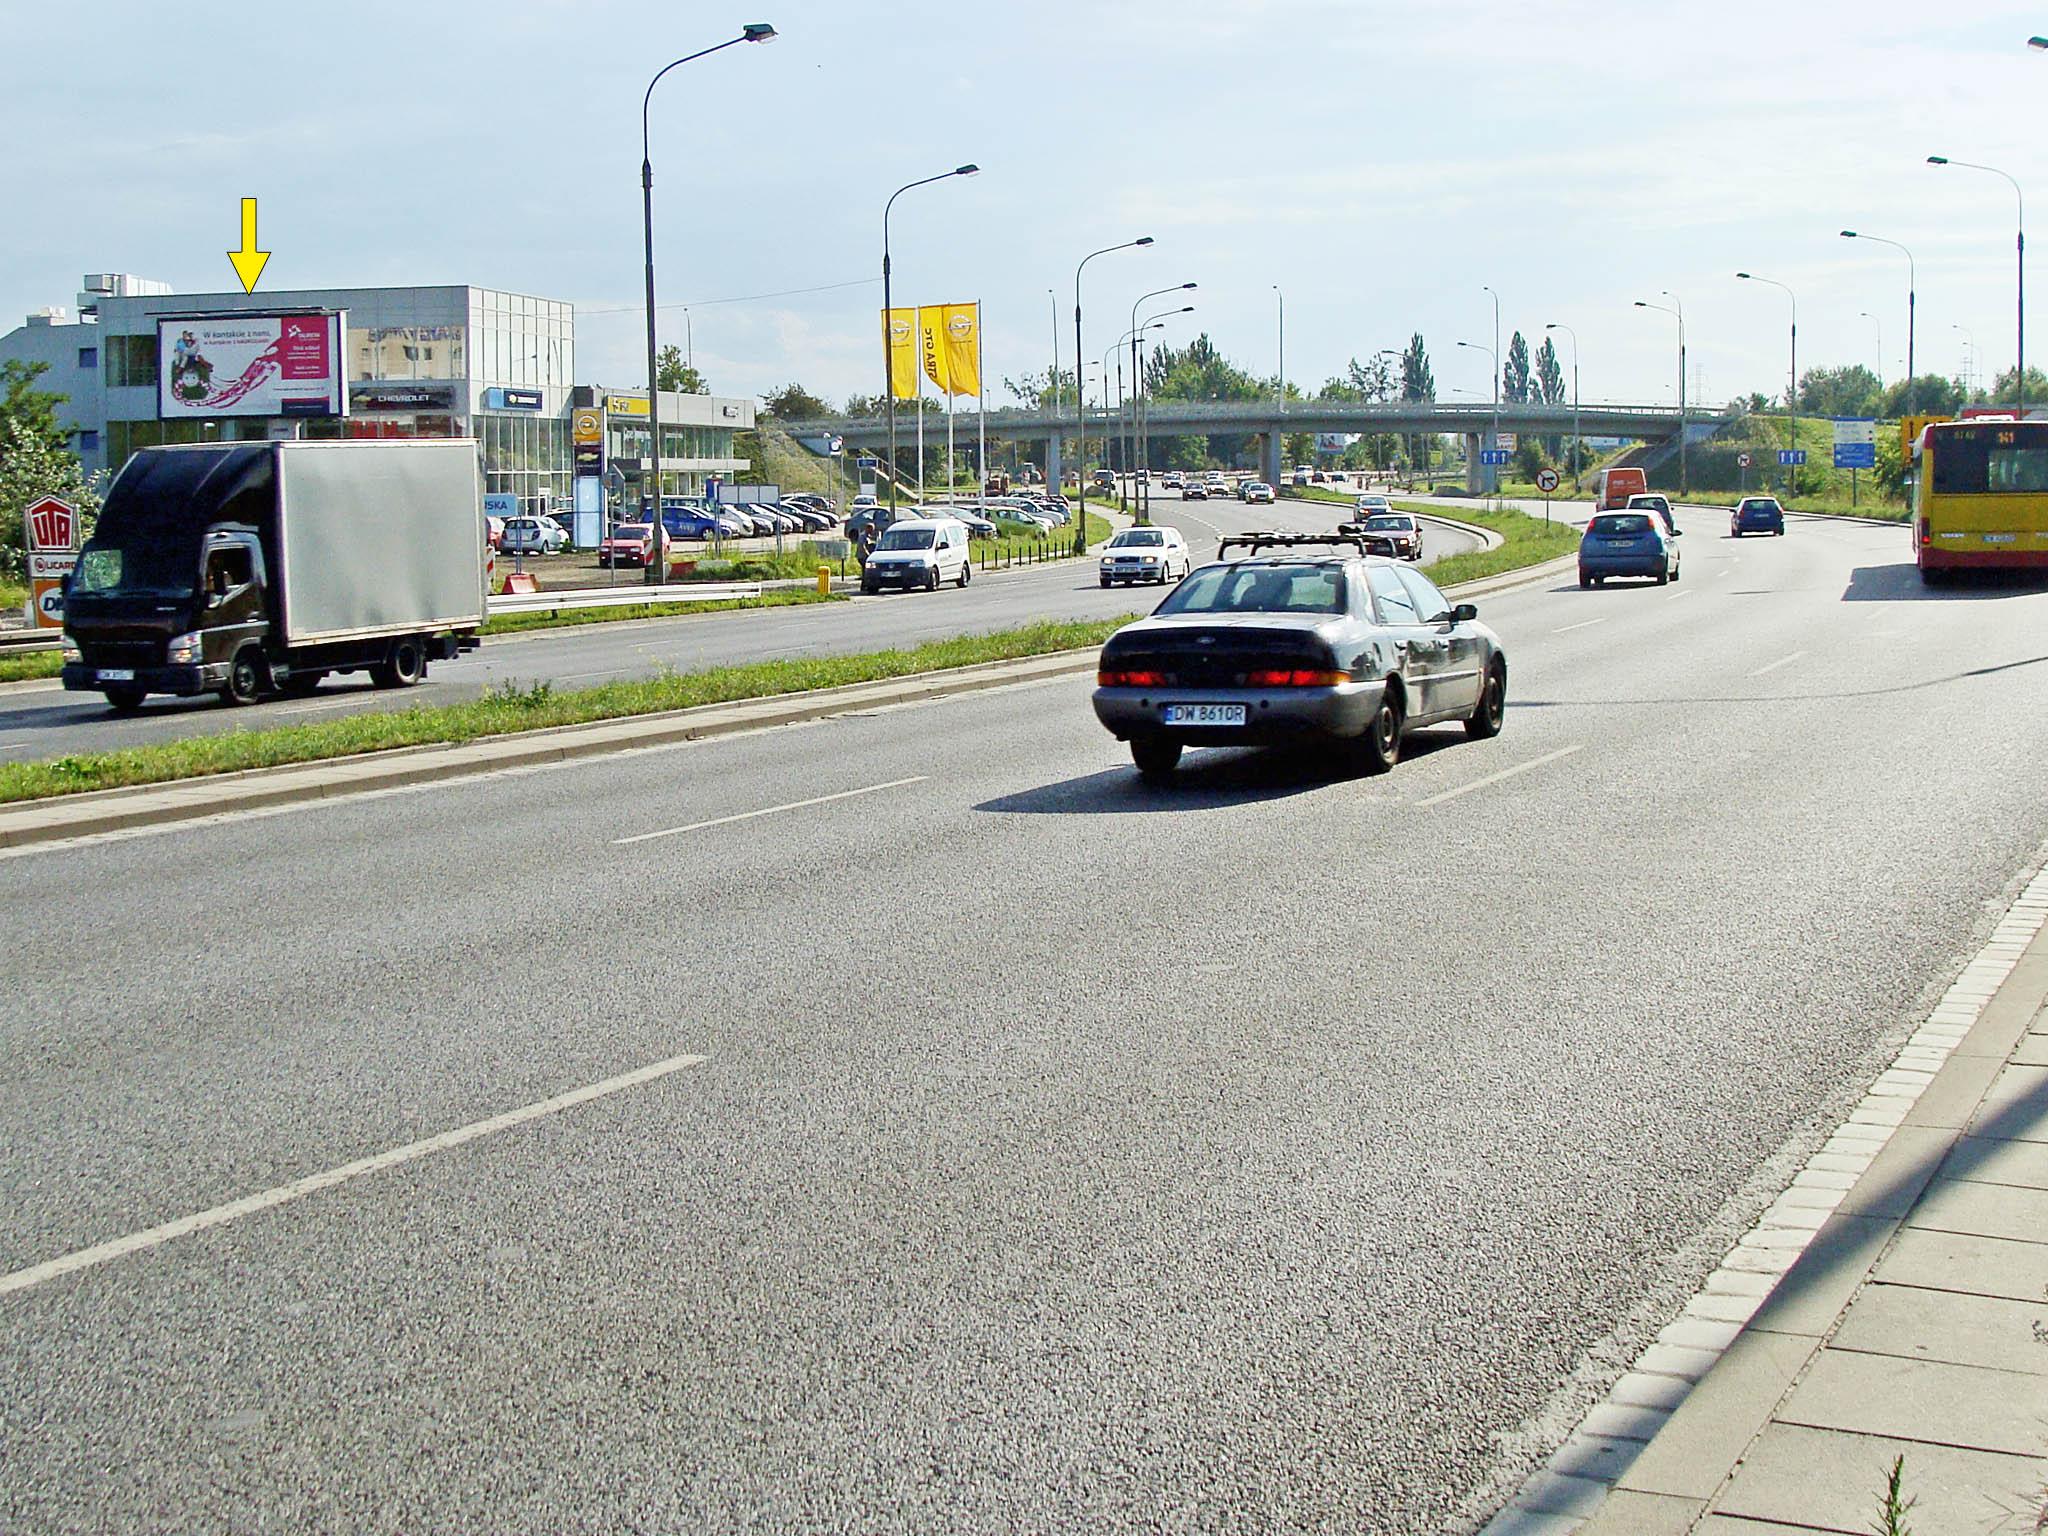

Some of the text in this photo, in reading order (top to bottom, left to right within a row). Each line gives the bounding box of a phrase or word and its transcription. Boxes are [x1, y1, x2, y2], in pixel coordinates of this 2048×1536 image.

[377, 394, 430, 403] CHEVROLET
[31, 501, 73, 547] UTA
[1174, 706, 1196, 721] DW
